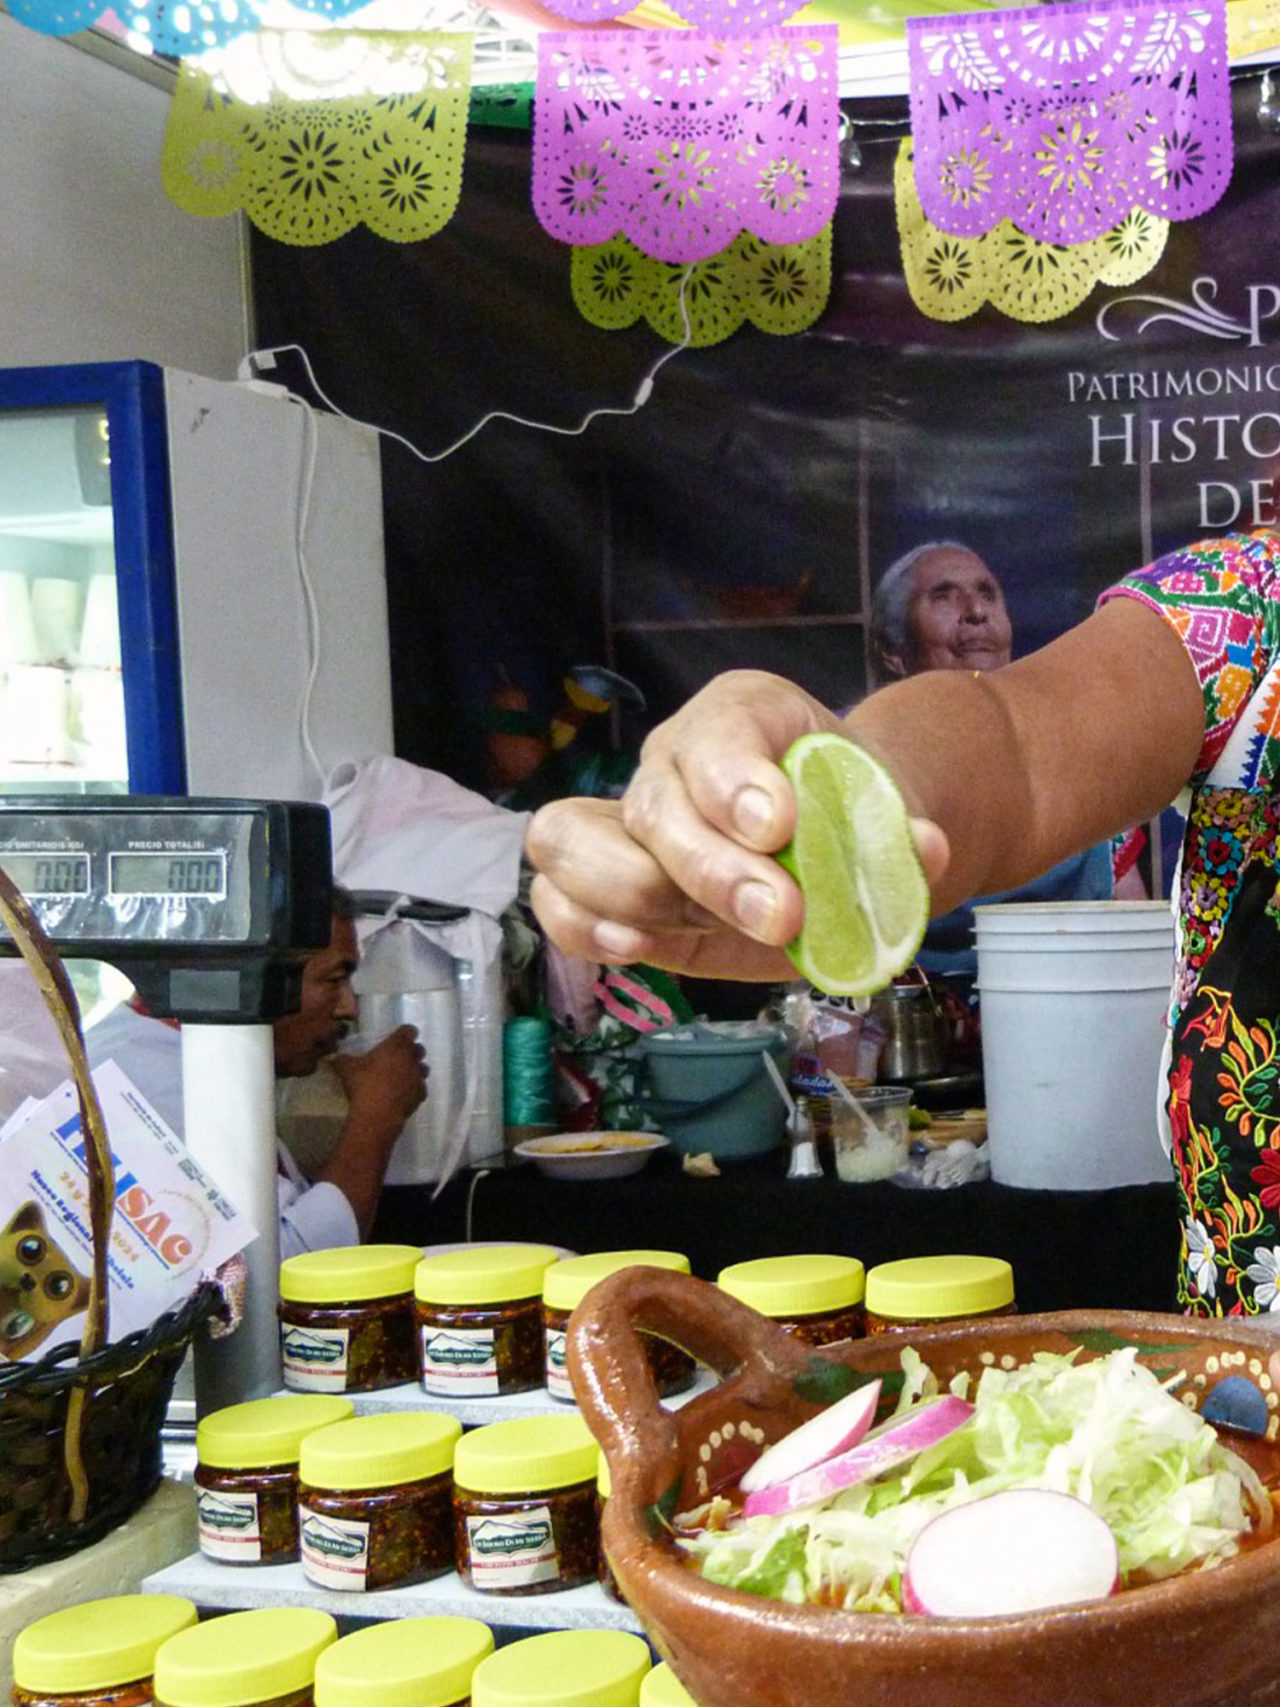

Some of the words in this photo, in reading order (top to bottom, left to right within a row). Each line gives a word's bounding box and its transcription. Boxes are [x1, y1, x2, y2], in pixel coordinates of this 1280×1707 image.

[127, 840, 163, 850] PRECIO
[31, 1169, 58, 1201] Museo
[56, 1199, 93, 1242] Regional
